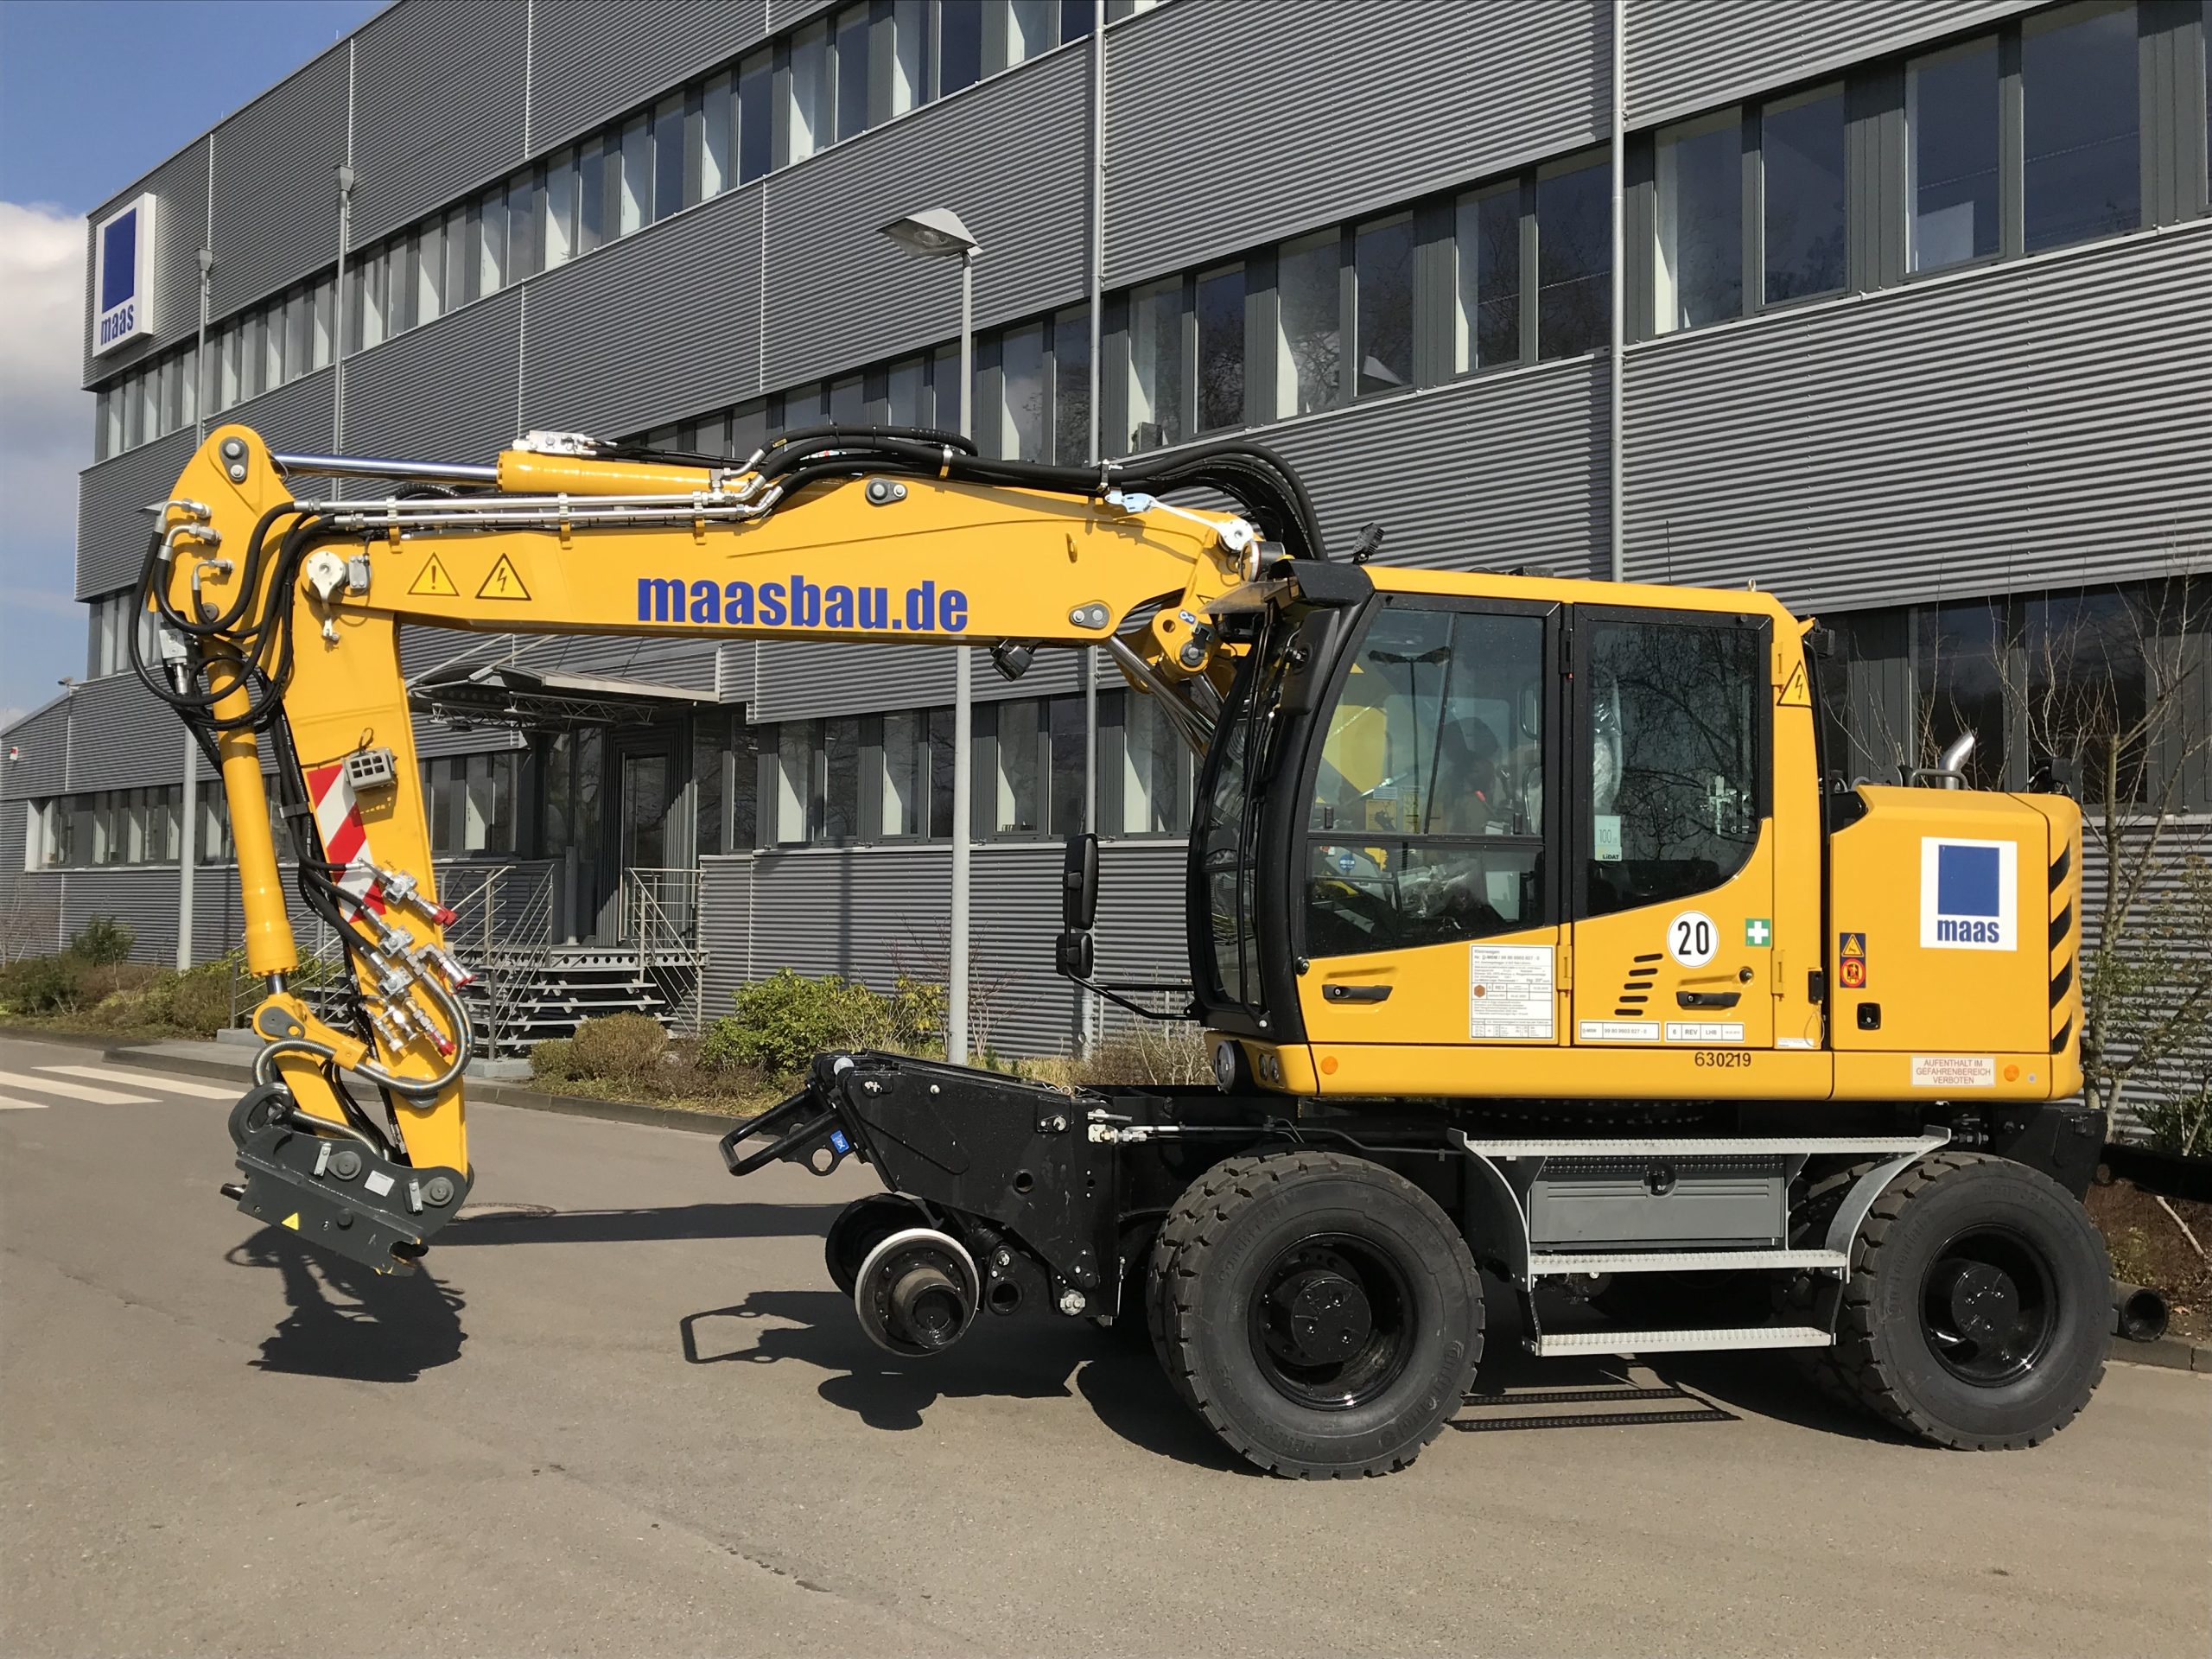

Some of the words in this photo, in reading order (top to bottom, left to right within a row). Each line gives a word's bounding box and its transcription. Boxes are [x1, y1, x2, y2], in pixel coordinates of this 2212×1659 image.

[100, 304, 134, 346] maas
[638, 575, 968, 632] maasbau.de
[1677, 920, 1710, 956] 20
[1937, 918, 2000, 944] maas
[1694, 1052, 1751, 1068] 630219
[1916, 1067, 1991, 1076] GEFAHRENBEREICH
